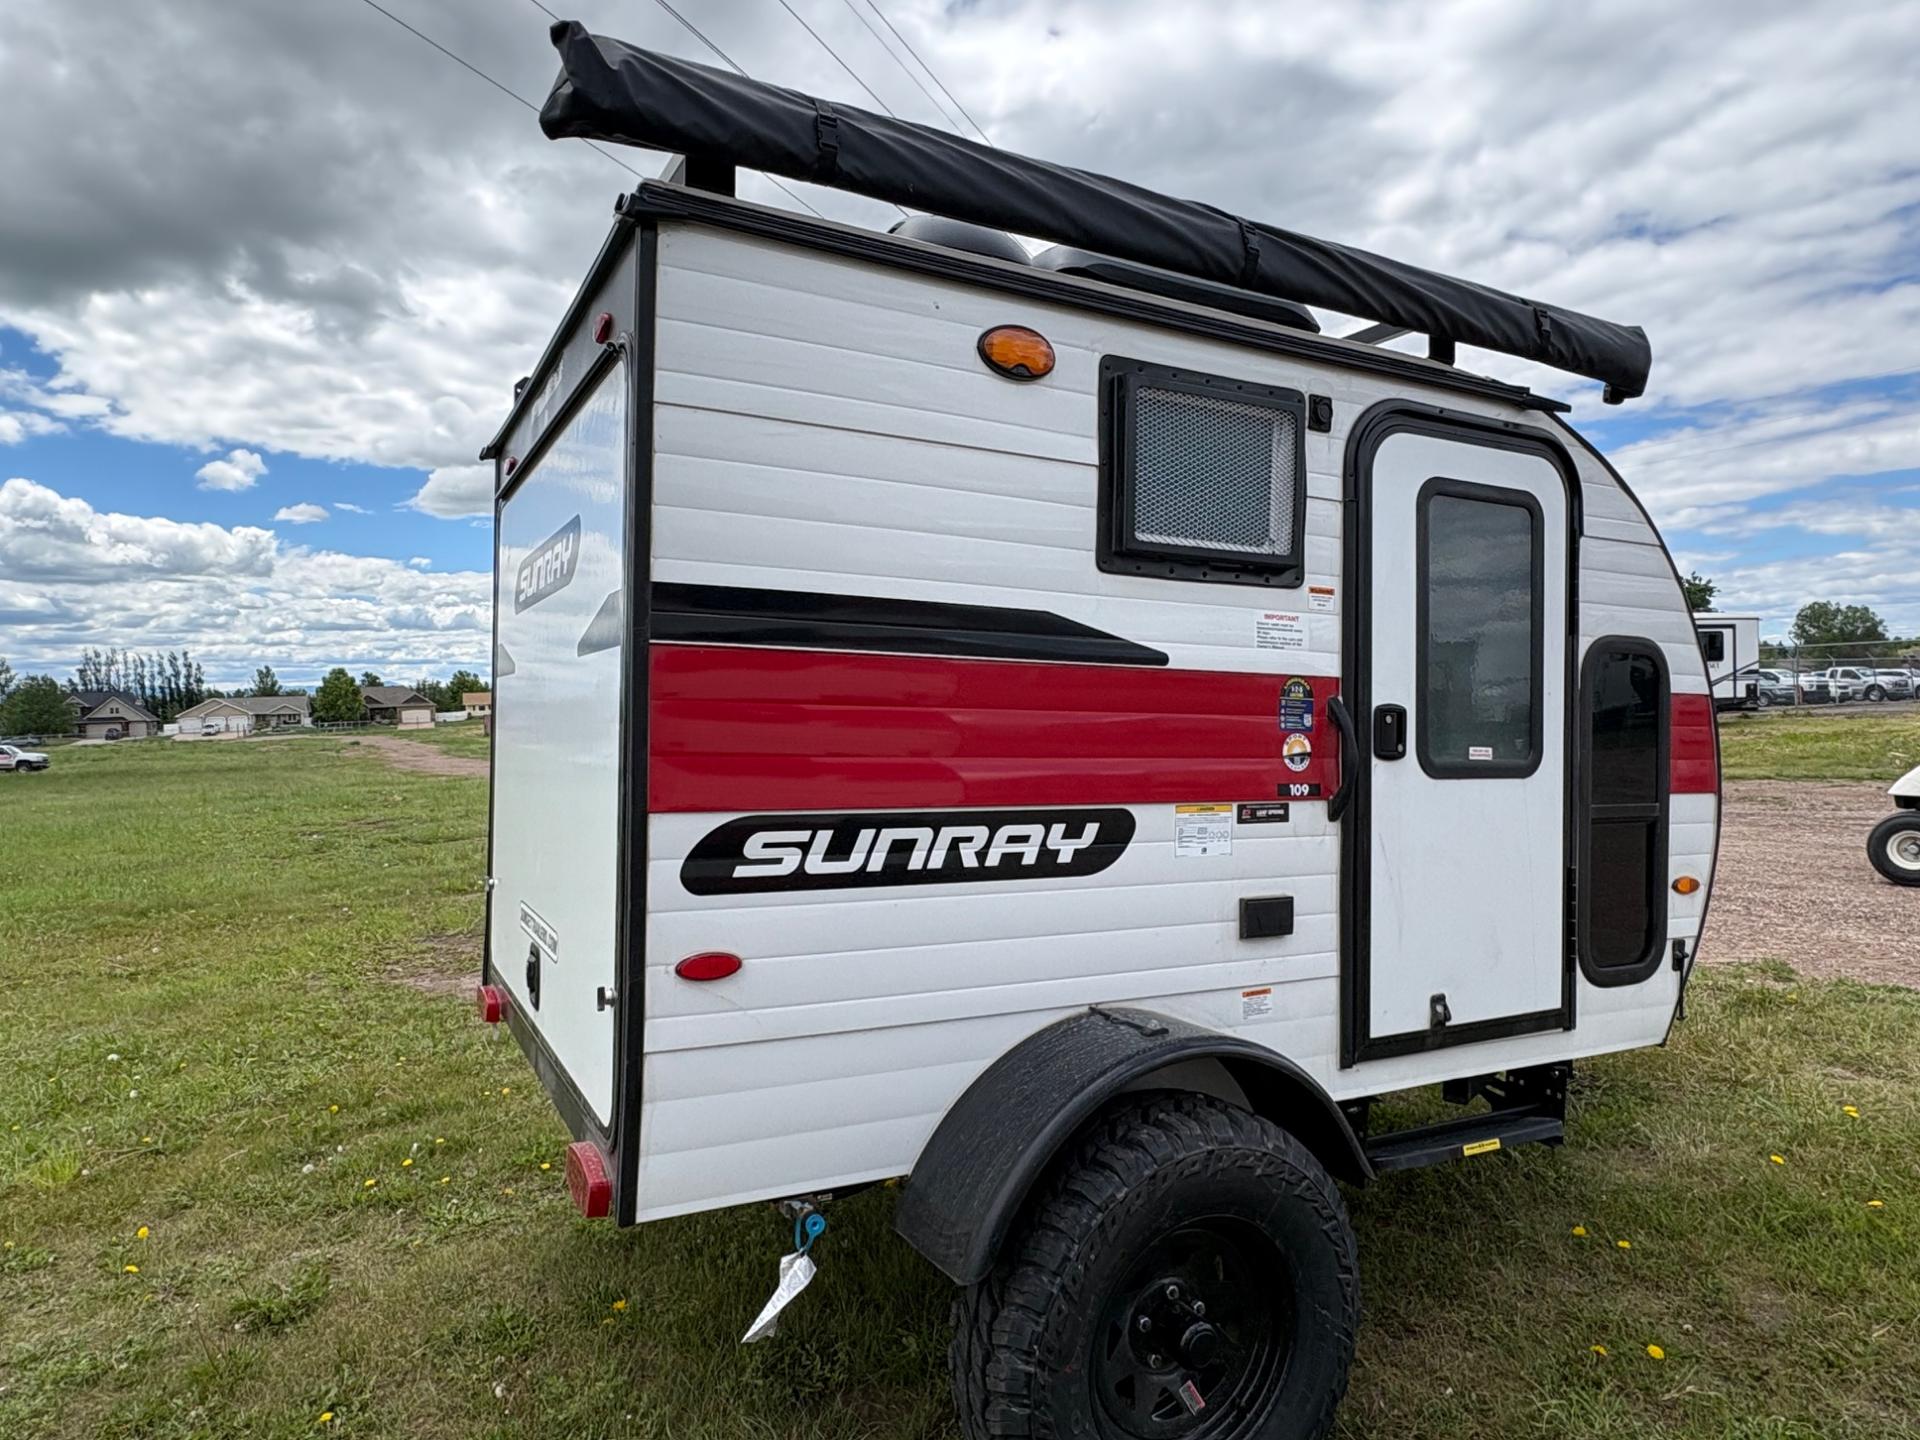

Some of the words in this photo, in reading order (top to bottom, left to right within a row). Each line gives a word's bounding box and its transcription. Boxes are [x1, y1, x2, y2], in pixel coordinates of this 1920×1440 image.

[519, 532, 574, 603] SUNRAY
[1289, 783, 1310, 797] 109
[732, 821, 1101, 879] SUNRAY
